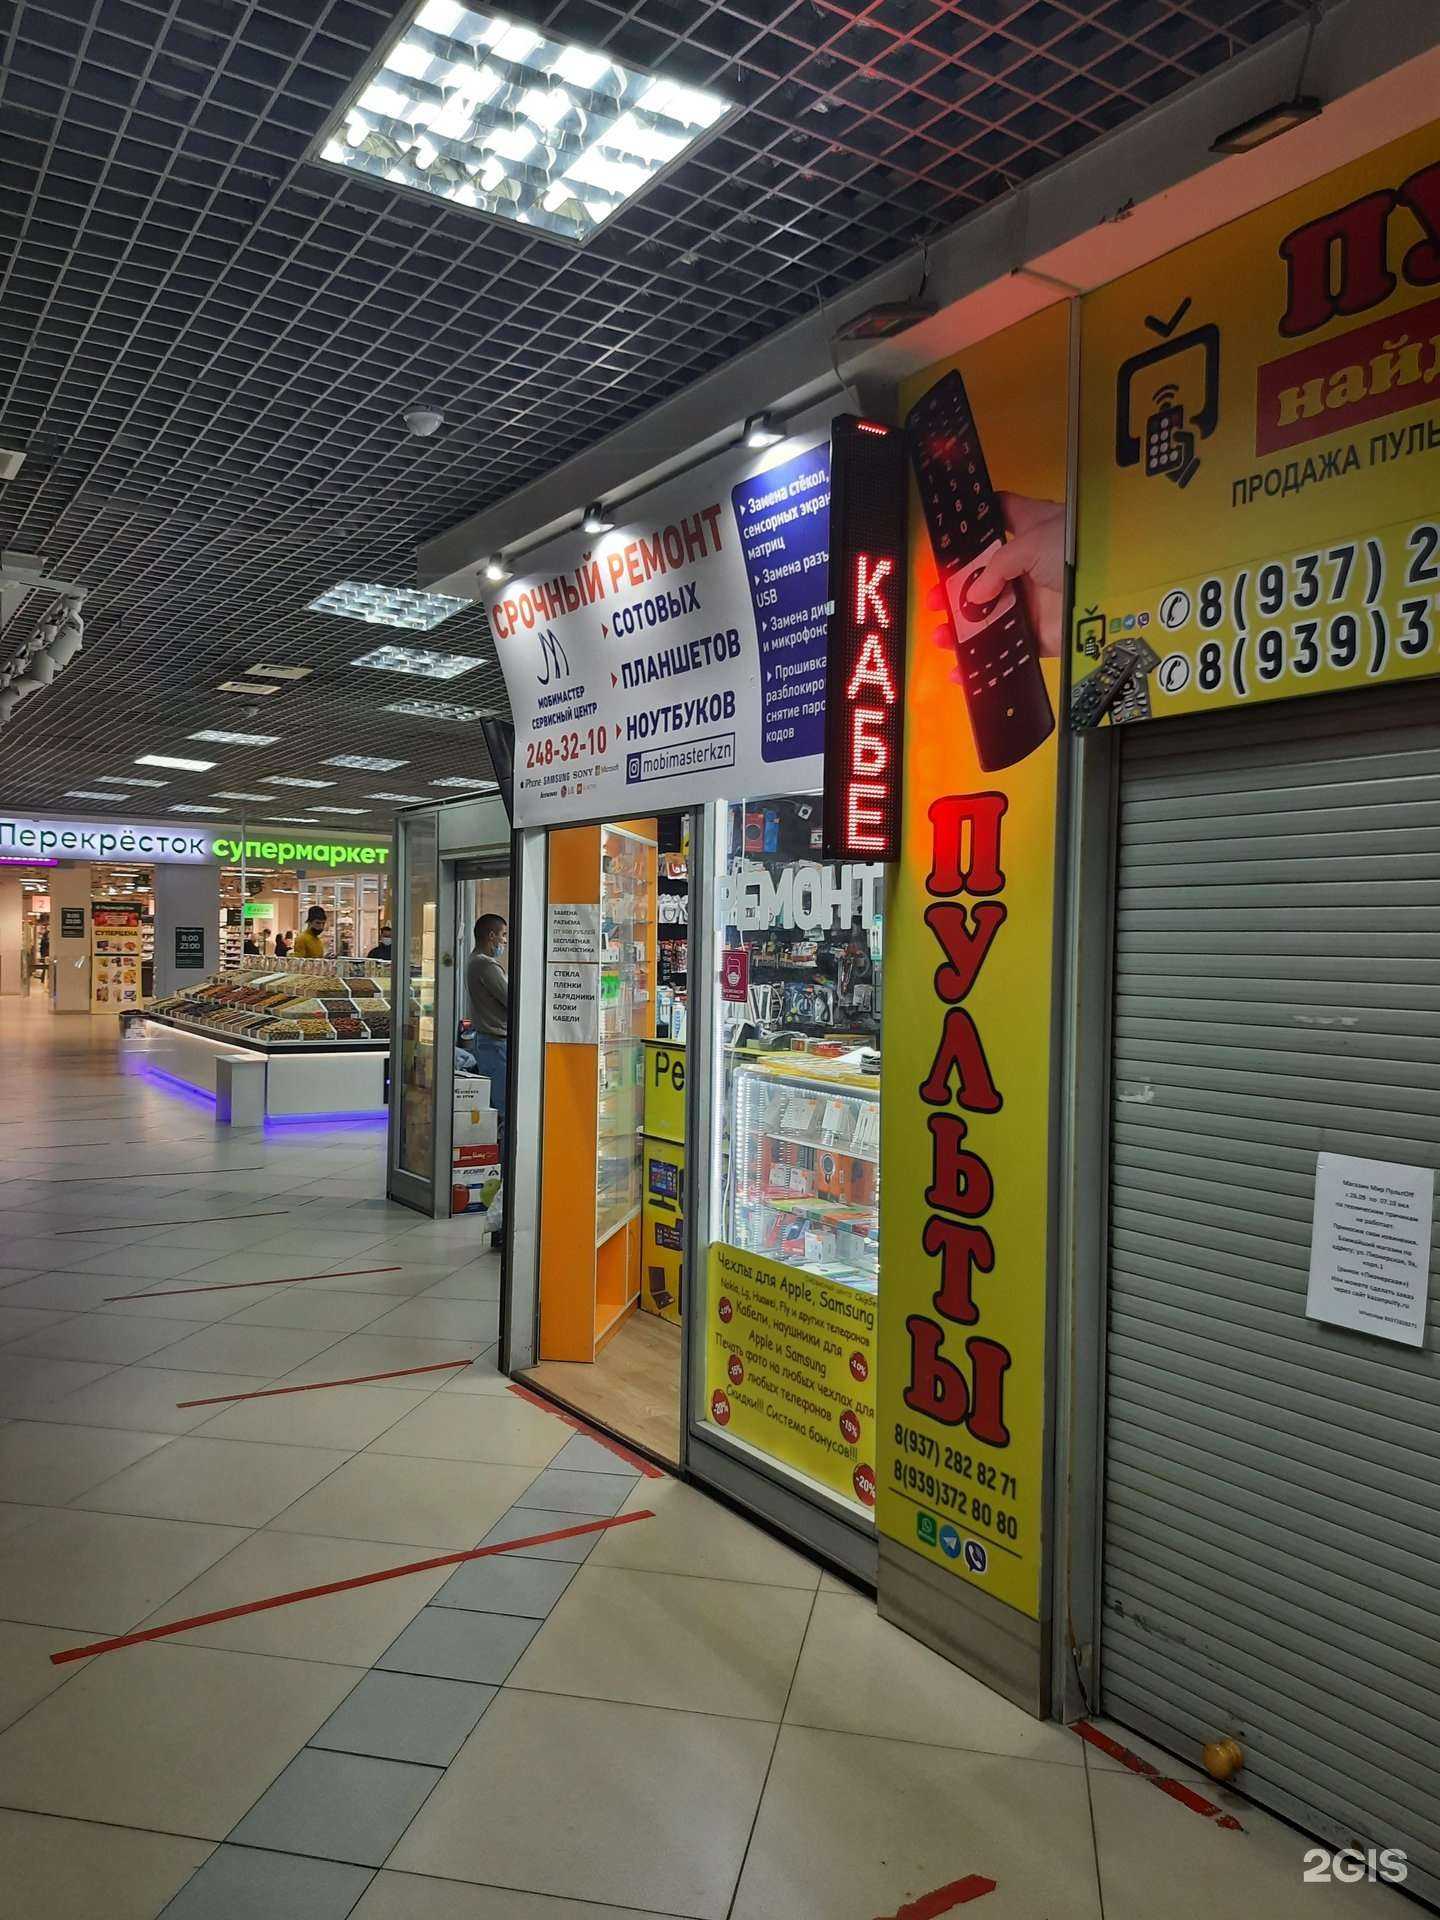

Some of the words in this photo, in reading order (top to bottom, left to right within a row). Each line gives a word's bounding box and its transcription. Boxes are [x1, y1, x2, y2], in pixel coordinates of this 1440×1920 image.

[1277, 335, 1440, 427] най
[1232, 444, 1360, 507] ПРОДАЖА
[748, 487, 787, 514] Замена
[743, 507, 799, 539] сенсорных
[747, 535, 786, 561] матриц
[492, 552, 605, 640] СРОЧНЫЙ
[606, 503, 722, 593] РЕМОНТ
[762, 559, 801, 584] Замена
[803, 550, 829, 573] разъ
[756, 588, 778, 608] USB
[1200, 541, 1382, 631] 8(937)
[612, 581, 701, 637] СОТОВЫХ
[770, 609, 808, 631] Замена
[621, 628, 741, 689] ПЛАНШЕТОВ
[763, 641, 770, 652] и
[775, 656, 827, 680] Прошивка
[538, 685, 585, 709] МОБИМАСТЕР
[766, 705, 800, 723] снятие
[847, 554, 896, 851] КАБЕ
[532, 706, 573, 730] СЕРВИСНЫЙ
[574, 702, 598, 720] ЦЕНТР
[627, 690, 736, 741] НОУТБУКОВ
[526, 725, 607, 769] 248-32-10
[766, 727, 794, 743] кодов
[643, 743, 731, 773] mobimasterkzn
[543, 772, 570, 786] SAMSUNG
[572, 768, 594, 780] SONY
[0, 823, 205, 855] Перекрёсток
[212, 839, 389, 867] супермаркет
[714, 862, 884, 931] РЕМОНТ
[553, 970, 580, 978] СТЕКЛА
[553, 981, 582, 989] ПЛЕНКИ
[553, 993, 595, 1001] ЗАРЯДНИКИ
[552, 1015, 580, 1023] КАБЕЛИ
[655, 1051, 685, 1091] Ре
[903, 792, 1011, 1448] ПУЛЬТЫ
[718, 1251, 752, 1279] Чехлы
[755, 1270, 776, 1288] для
[779, 1275, 815, 1306] Apple,
[820, 1290, 874, 1331] Samsung
[736, 1299, 770, 1328] Кабели,
[773, 1319, 820, 1348] наушники
[823, 1340, 842, 1357] для
[826, 1322, 870, 1347] телефонов
[748, 1329, 773, 1350] Apple
[775, 1343, 782, 1355] и
[785, 1345, 826, 1378] Samsung
[715, 1332, 743, 1356] Печать
[745, 1349, 767, 1368] фото
[769, 1360, 780, 1374] на
[782, 1367, 815, 1388] любых
[817, 1384, 853, 1408] чехлах
[855, 1401, 875, 1419] для
[748, 1373, 779, 1395] любых
[781, 1388, 832, 1421] телефонов
[766, 1404, 806, 1435] Система
[894, 1424, 941, 1468] 8(937)
[945, 1447, 972, 1480] 282
[976, 1461, 997, 1491] 82
[1000, 1472, 1017, 1500] 71
[855, 1476, 876, 1498] -20%
[972, 1498, 992, 1527] 80
[996, 1511, 1017, 1540] 80
